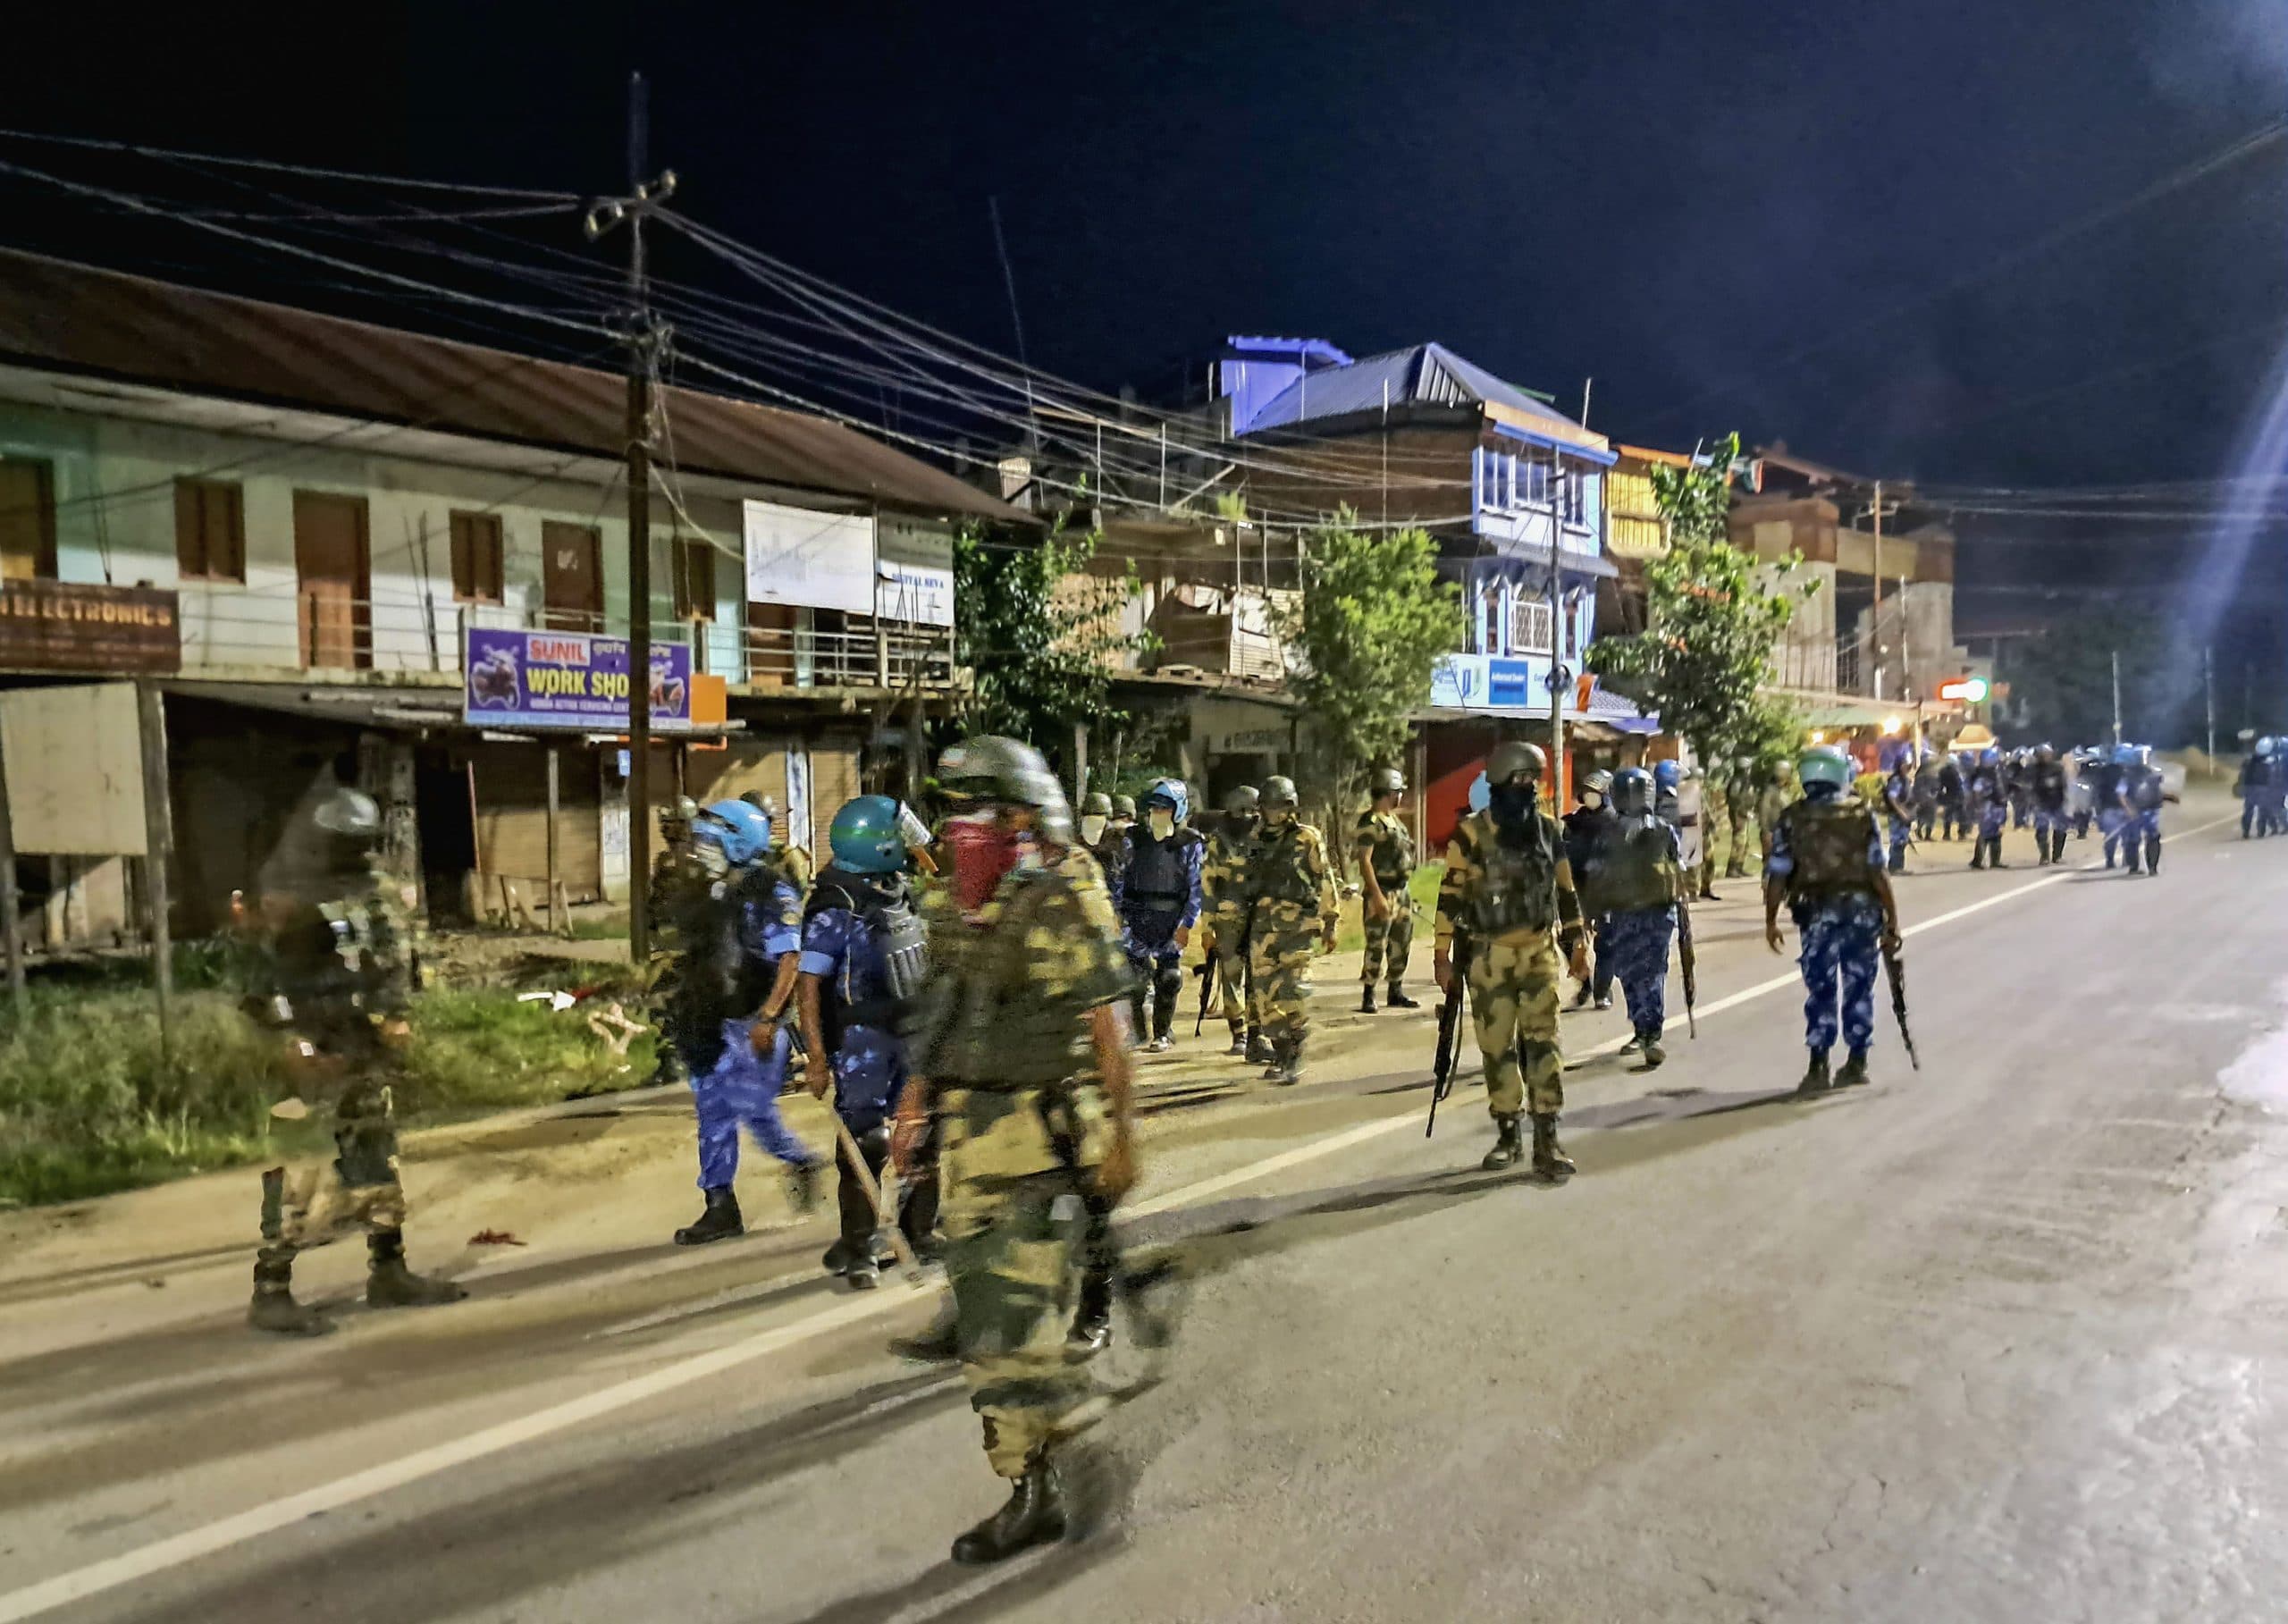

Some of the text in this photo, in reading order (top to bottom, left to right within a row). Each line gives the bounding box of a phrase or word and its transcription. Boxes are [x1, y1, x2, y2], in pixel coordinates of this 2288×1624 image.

[530, 639, 587, 663] SUNIL
[526, 667, 629, 698] WORK SHO
